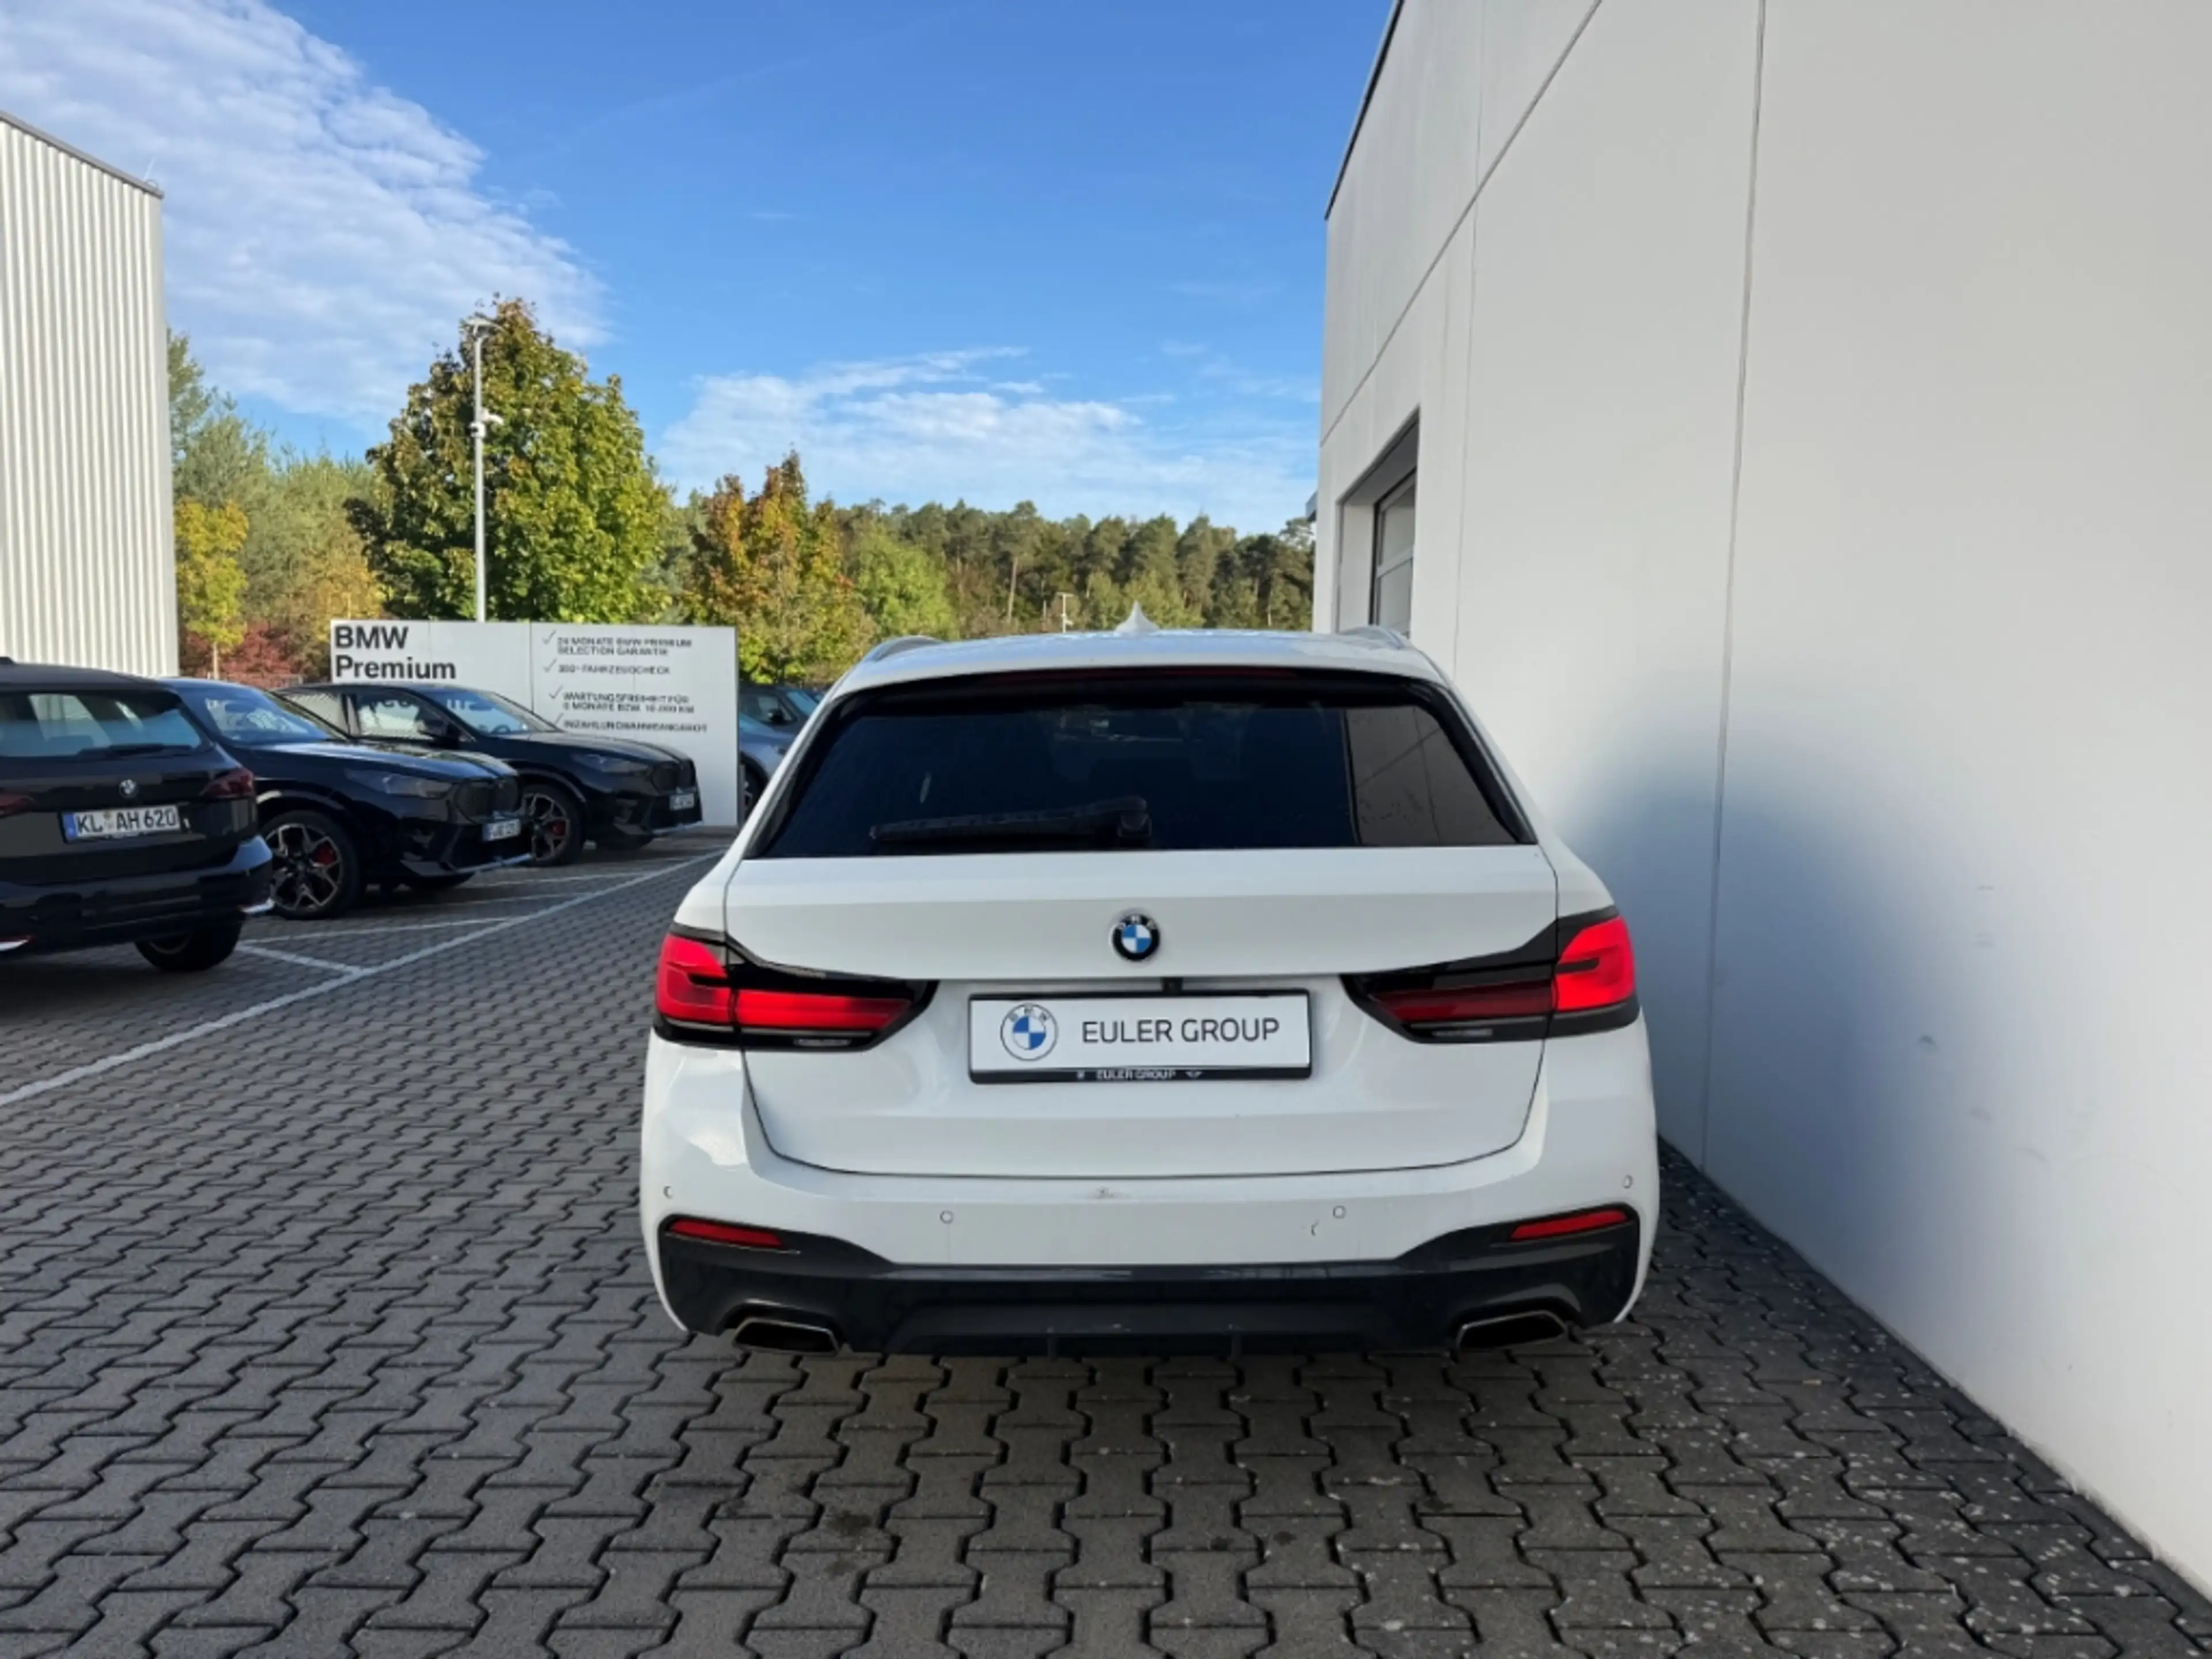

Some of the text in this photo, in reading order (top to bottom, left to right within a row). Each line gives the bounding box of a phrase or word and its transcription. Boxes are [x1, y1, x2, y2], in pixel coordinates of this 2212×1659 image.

[336, 626, 409, 649] BMW
[571, 637, 613, 645] MONATE
[558, 646, 614, 655] SELECTION
[336, 655, 456, 679] Premium
[572, 702, 615, 711] MONATE
[76, 809, 177, 834] KL AH 620
[1082, 1018, 1280, 1044] EULER GROUP
[1097, 1069, 1176, 1080] EULER GROUP
